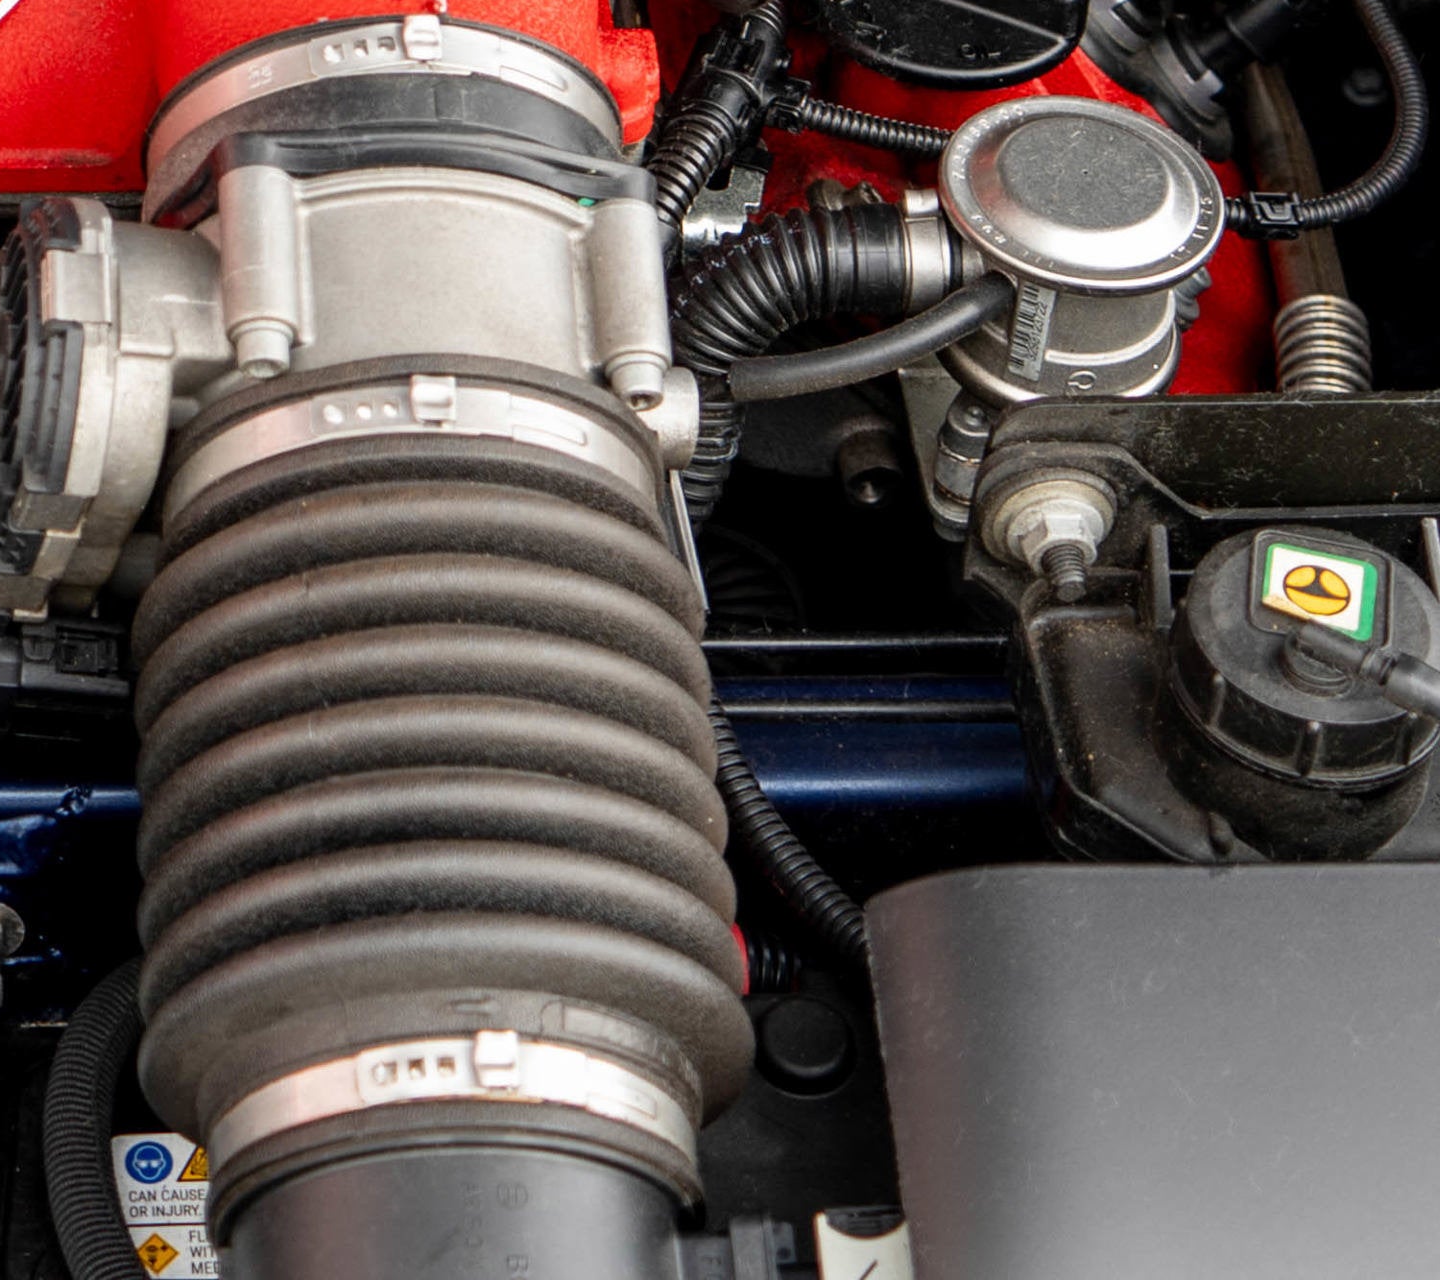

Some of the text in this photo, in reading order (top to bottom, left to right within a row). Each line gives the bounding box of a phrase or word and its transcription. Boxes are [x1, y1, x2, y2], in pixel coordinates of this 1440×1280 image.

[128, 1187, 206, 1203] CAN CAUSE
[129, 1206, 149, 1217] OR
